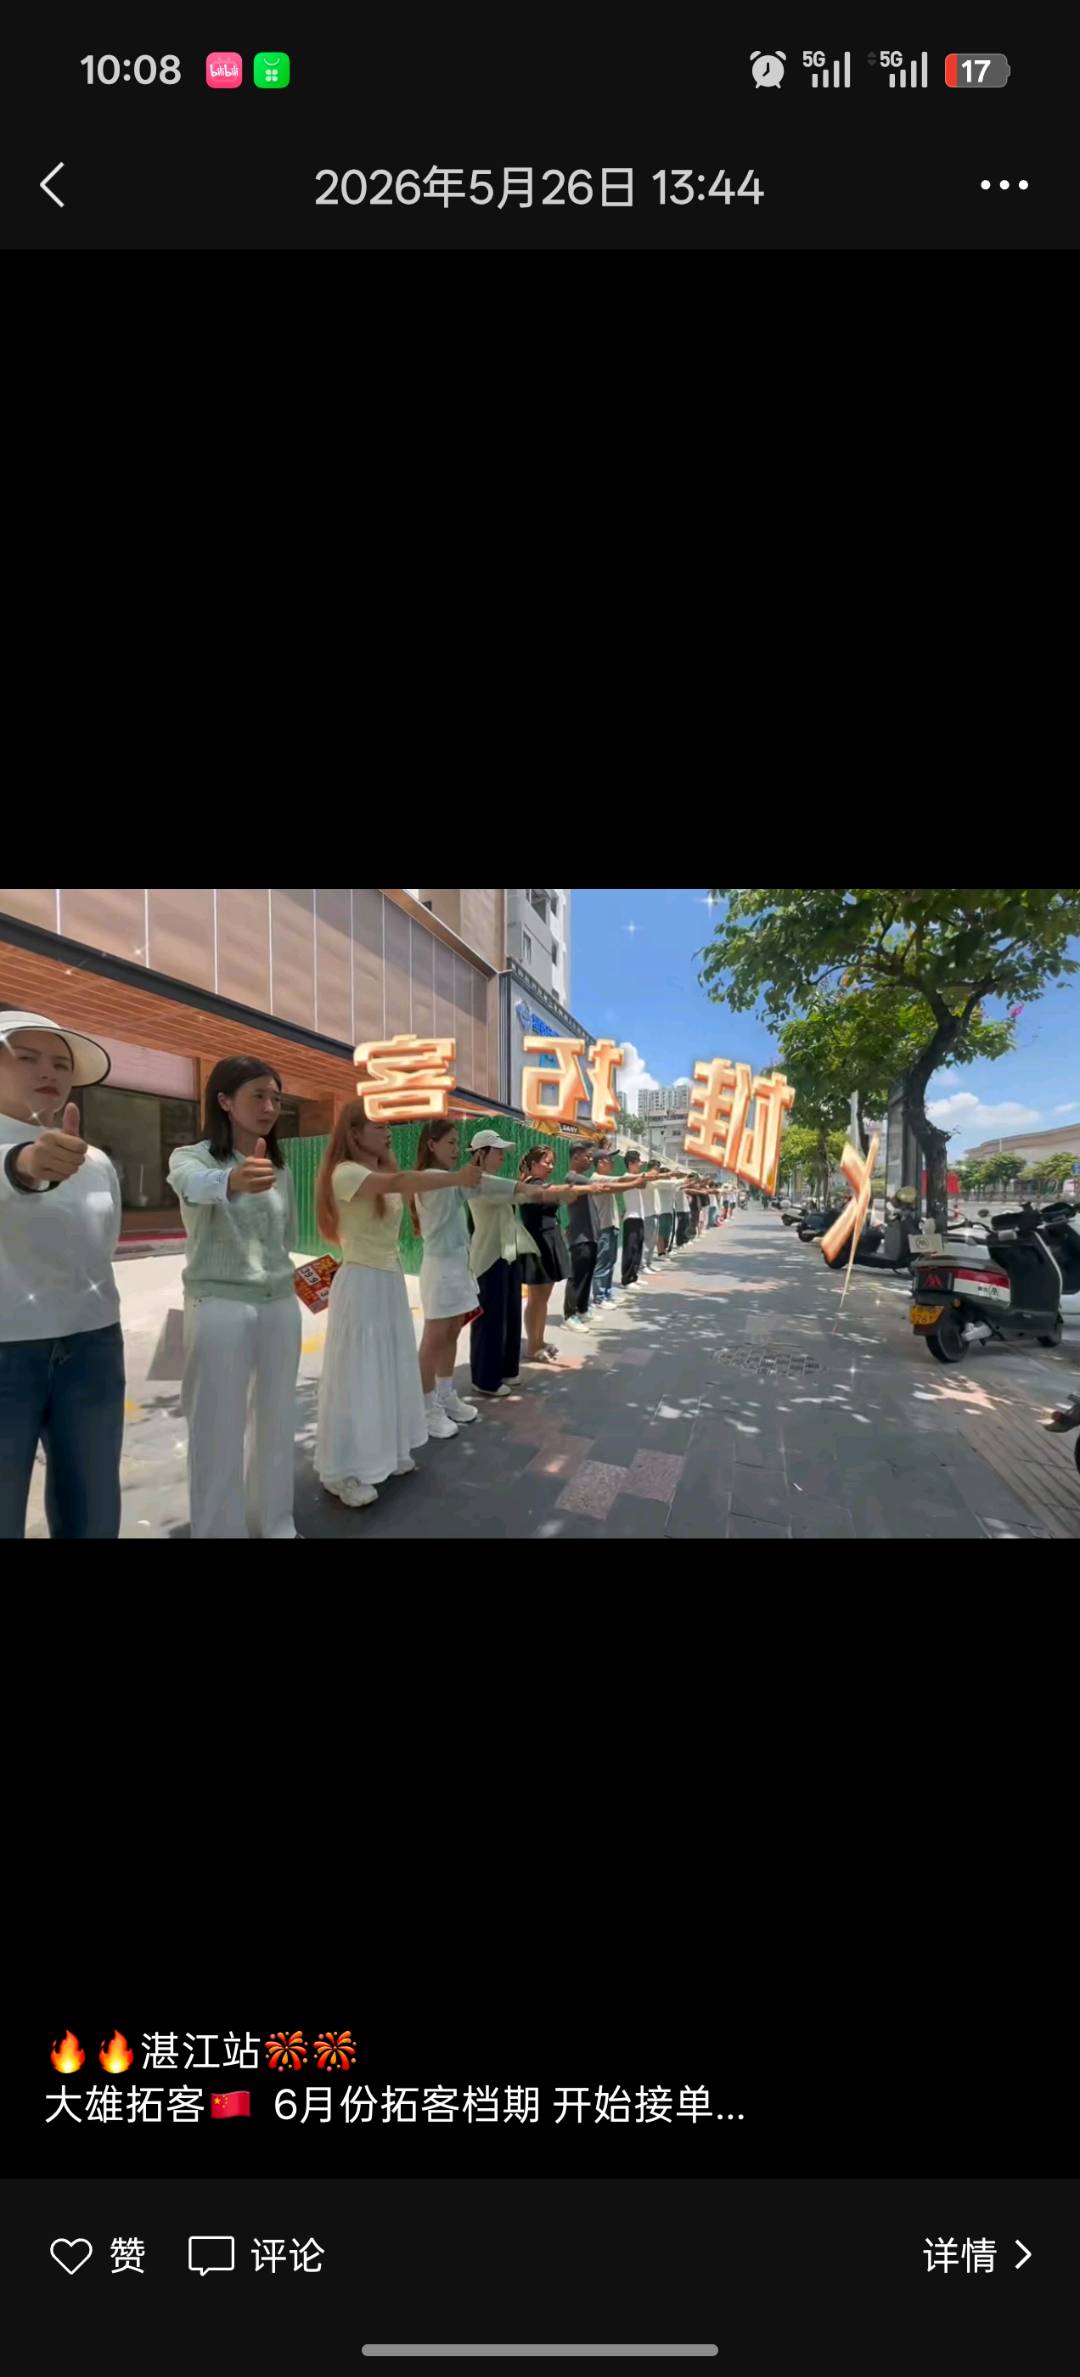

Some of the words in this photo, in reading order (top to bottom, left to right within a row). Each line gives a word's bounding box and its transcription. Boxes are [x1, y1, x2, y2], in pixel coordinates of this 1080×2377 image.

[81, 53, 182, 86] 10:08
[209, 64, 239, 77] bilibili
[802, 50, 826, 68] 5G
[879, 50, 904, 68] 5G
[961, 59, 991, 83] 17
[315, 164, 634, 210] 2026年5月26日
[652, 169, 765, 206] 13:44
[141, 2031, 261, 2070] 湛江站
[45, 2085, 205, 2124] 大雄拓客
[274, 2085, 539, 2124] 6月份拓客档期
[552, 2085, 745, 2125] 开始接单...
[109, 2237, 146, 2274] 赞
[250, 2237, 326, 2274] 评论
[922, 2237, 998, 2274] 详情
